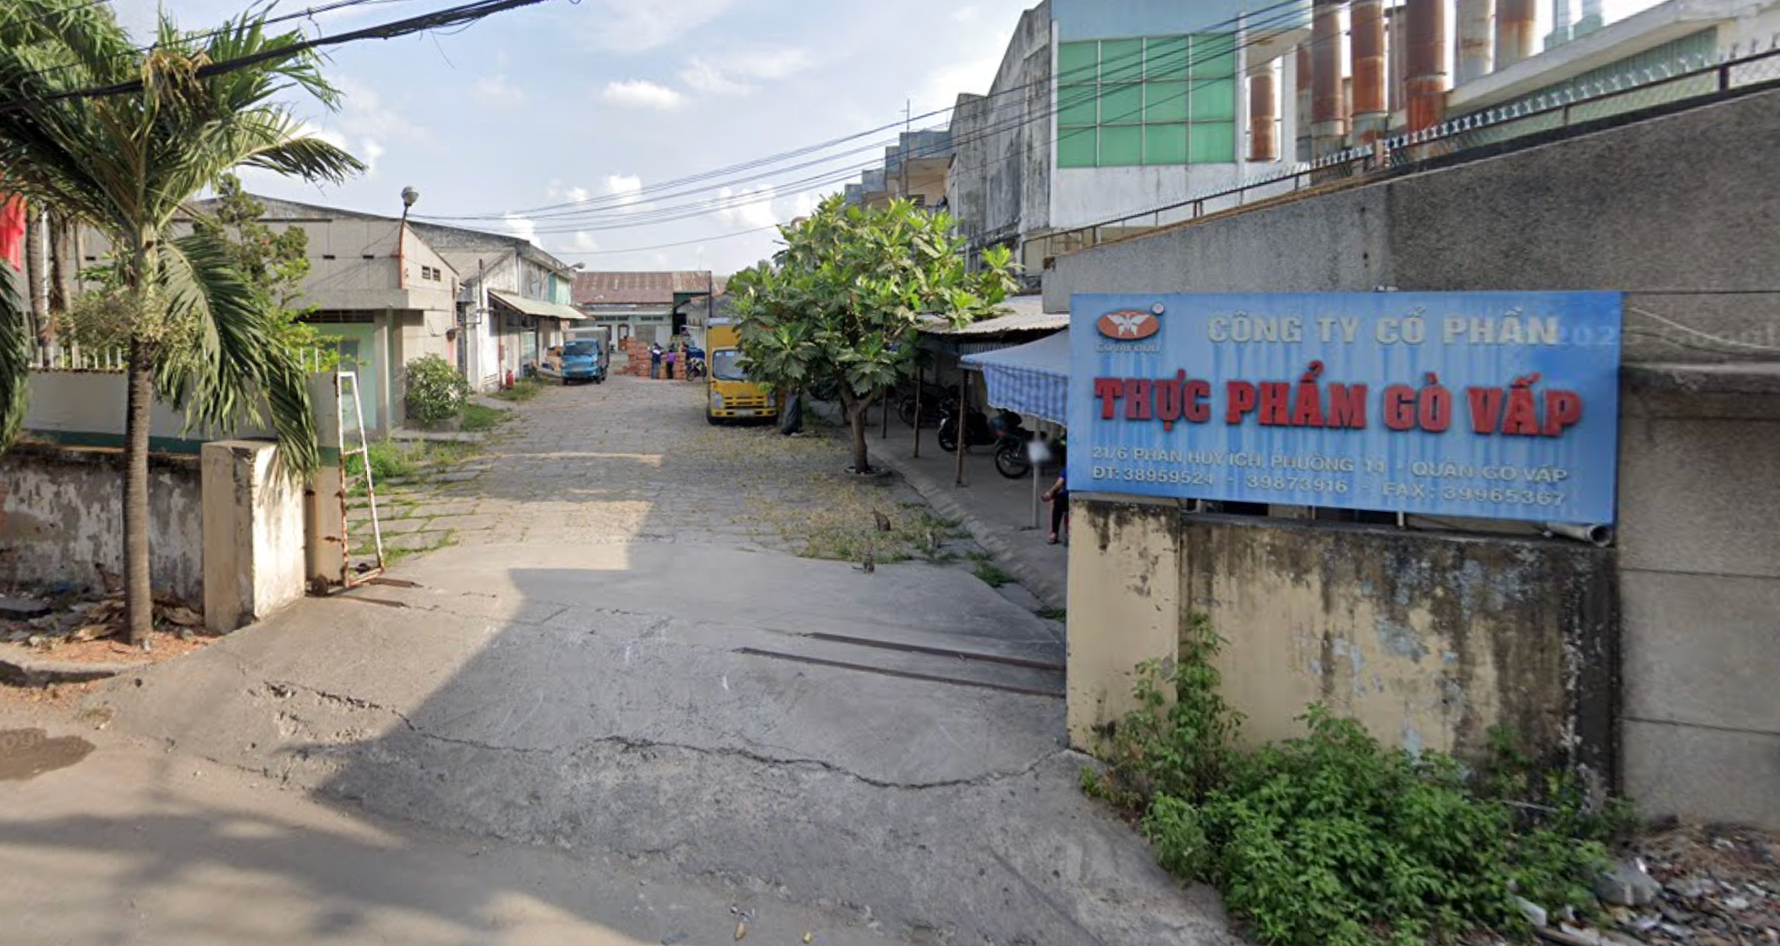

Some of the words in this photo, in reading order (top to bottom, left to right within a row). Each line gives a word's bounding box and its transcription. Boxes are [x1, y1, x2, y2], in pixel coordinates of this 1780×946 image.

[1209, 310, 1302, 343] CÔNG
[1318, 317, 1360, 343] TY
[1376, 306, 1426, 344] CỔ
[1444, 305, 1560, 345] PHẦN
[1094, 368, 1211, 432] THỰC
[1226, 360, 1368, 429] PHẨM
[1384, 371, 1452, 432] GÒ
[1466, 372, 1583, 437] VẤP
[1133, 447, 1183, 463] PHAN
[1188, 450, 1223, 466] HUY
[1246, 474, 1349, 494] 39873916
